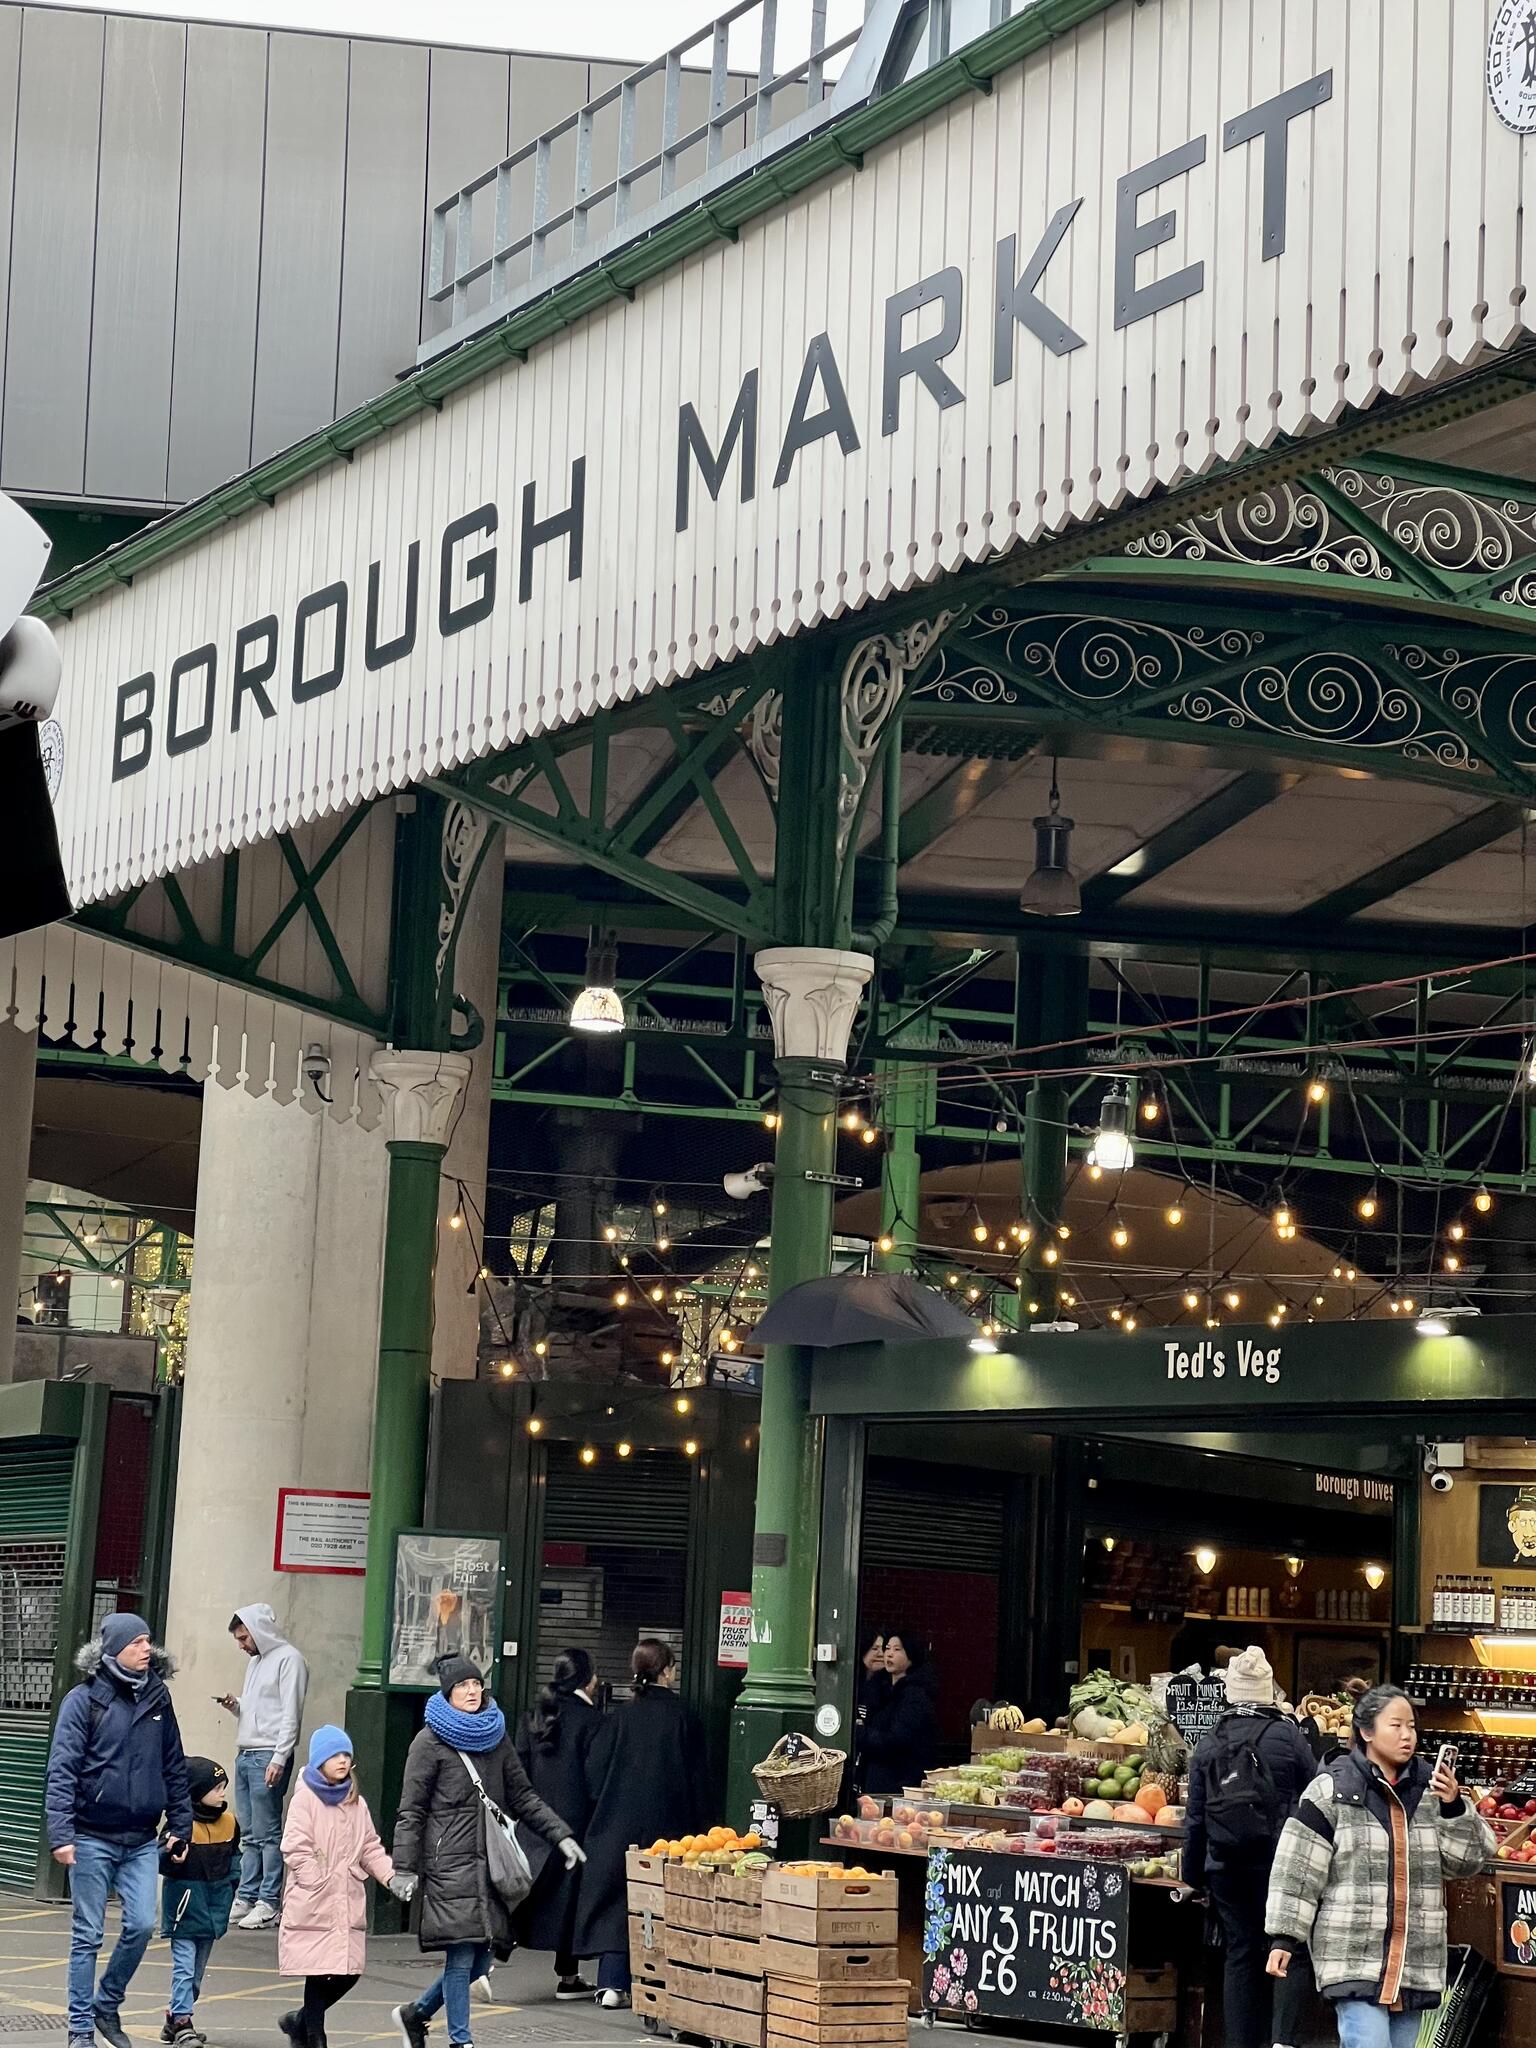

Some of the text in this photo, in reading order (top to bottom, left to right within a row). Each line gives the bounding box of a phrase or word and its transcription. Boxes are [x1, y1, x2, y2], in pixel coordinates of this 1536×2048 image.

[111, 68, 1333, 783] BOROUGH MARKET
[1164, 1340, 1282, 1384] Ted's Veg
[1315, 1473, 1360, 1500] Borough
[722, 1626, 749, 1634] TRUST
[722, 1633, 745, 1641] YOUR
[1170, 1683, 1192, 1697] FRUIT
[947, 1863, 1081, 1908] MIX and MATCH
[951, 1902, 1117, 1959] ANY 3 FRUITS
[977, 1950, 1018, 1996] £6
